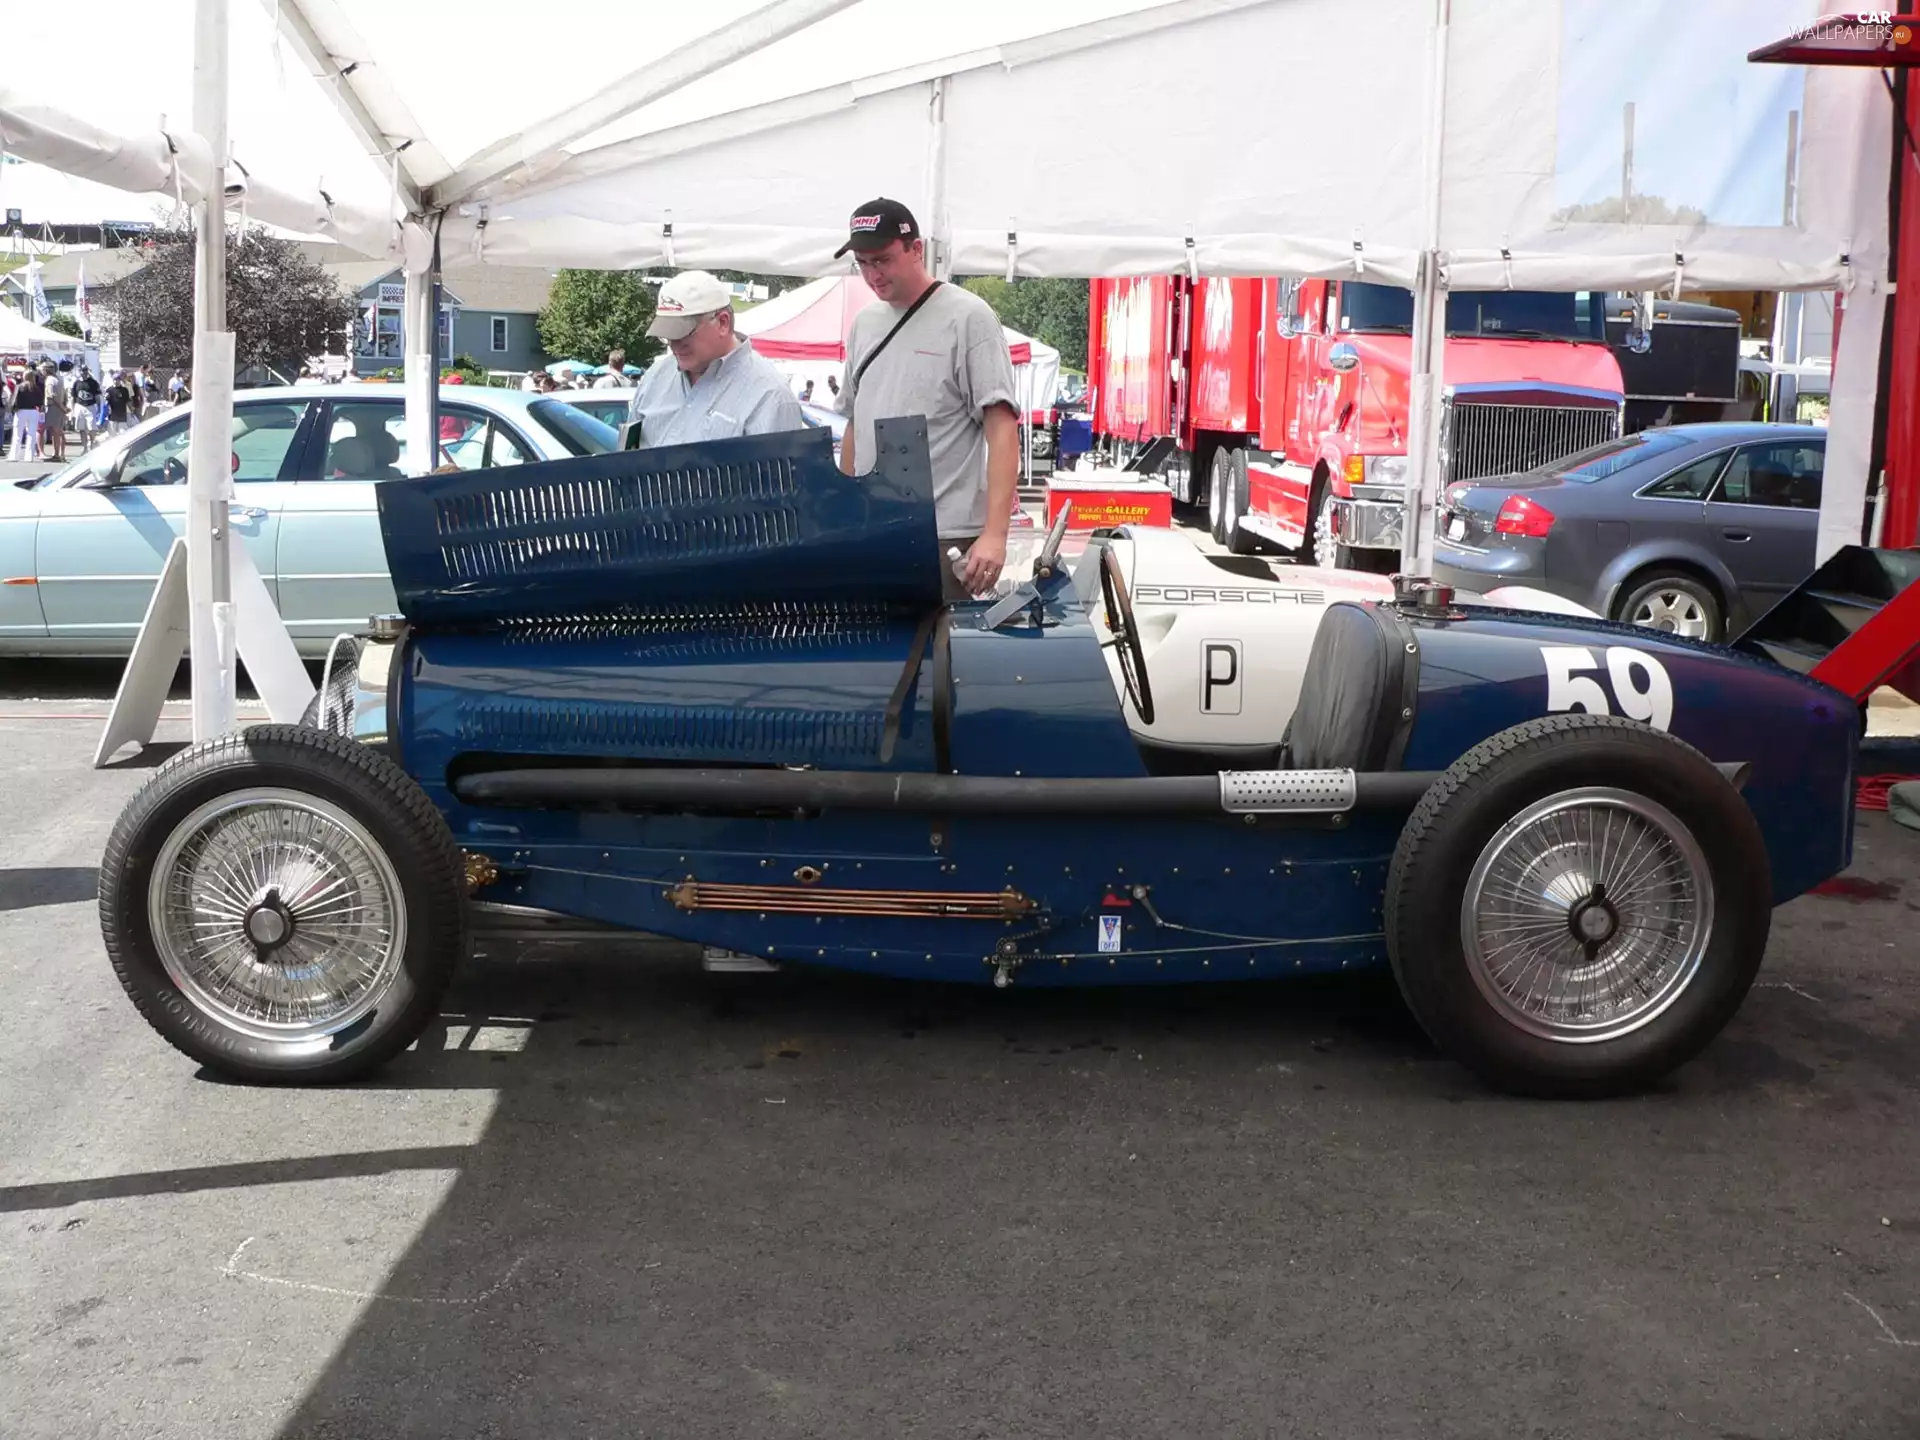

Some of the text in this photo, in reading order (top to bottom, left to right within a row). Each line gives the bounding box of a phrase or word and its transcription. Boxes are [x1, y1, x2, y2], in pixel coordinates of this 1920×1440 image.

[1135, 588, 1326, 604] PORSCHE
[1205, 644, 1237, 710] P
[1539, 647, 1673, 732] 59
[156, 988, 237, 1051] DUNLOP
